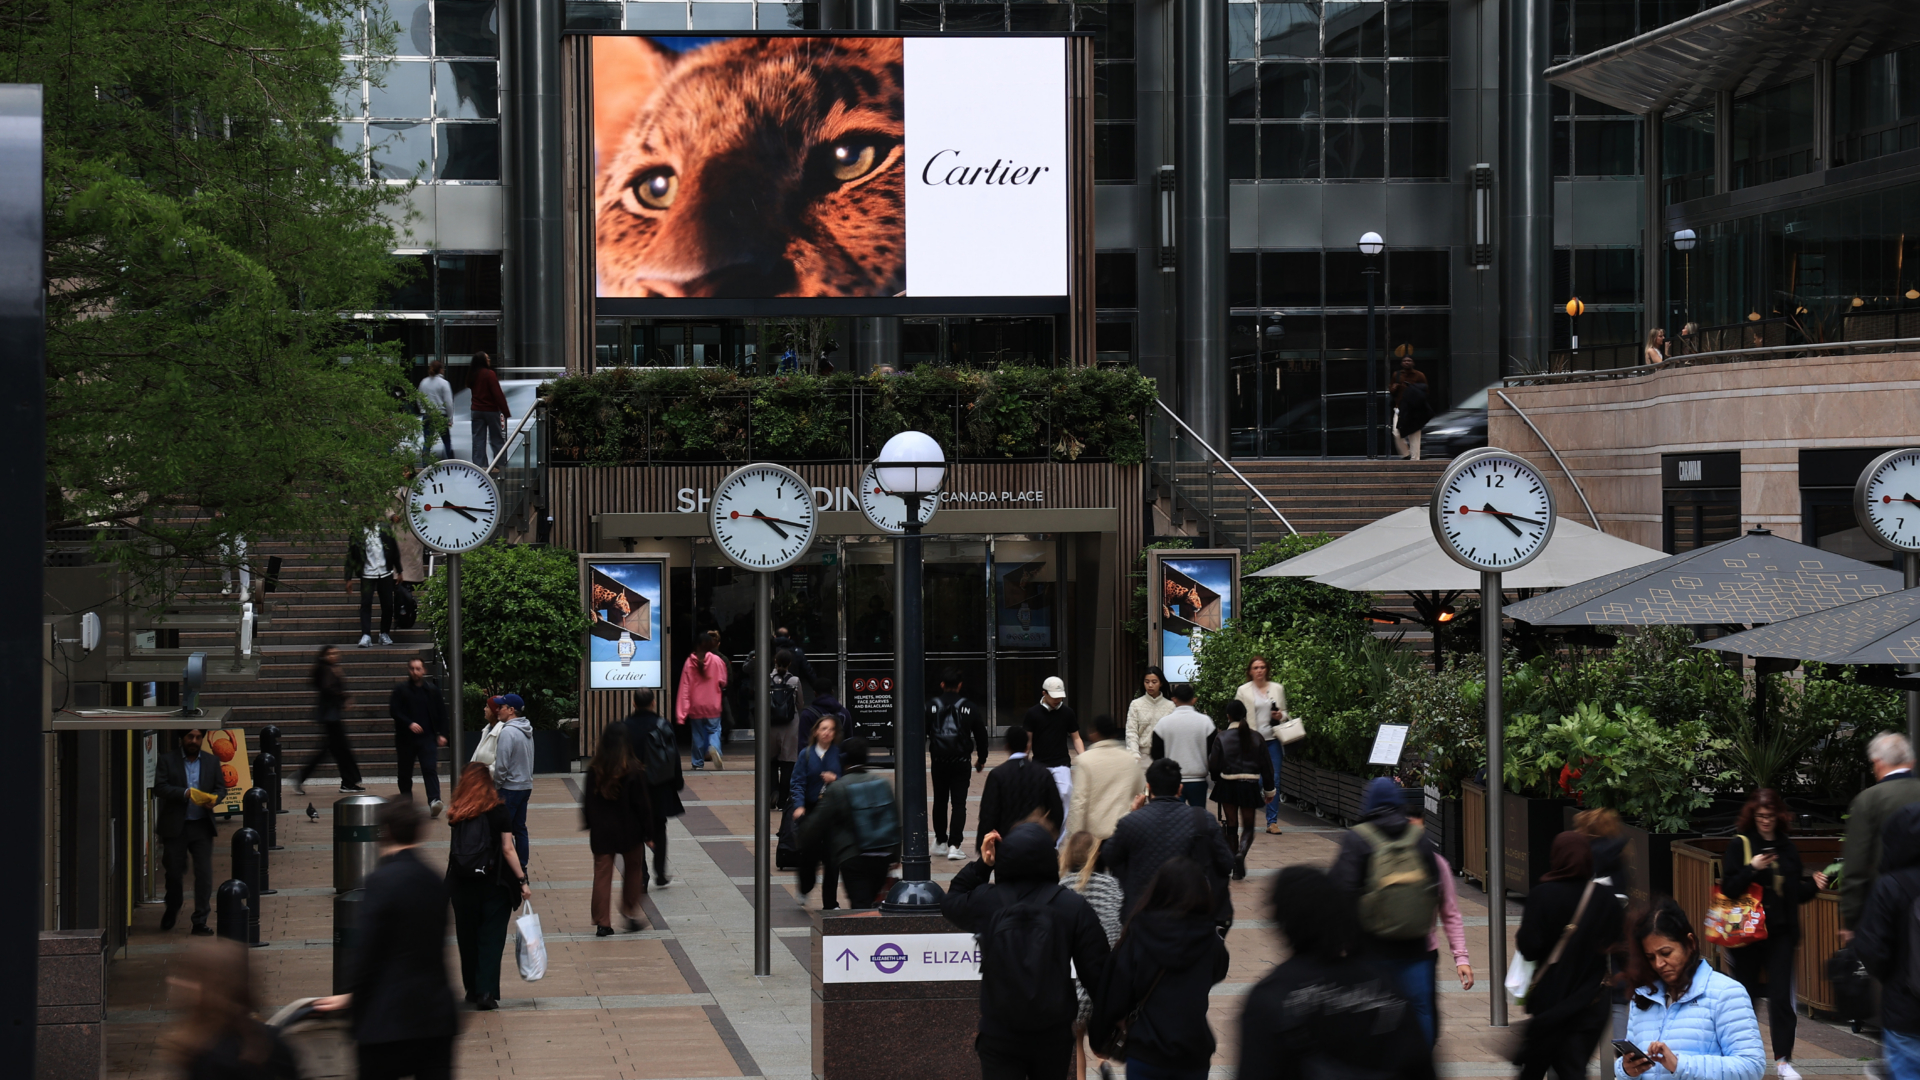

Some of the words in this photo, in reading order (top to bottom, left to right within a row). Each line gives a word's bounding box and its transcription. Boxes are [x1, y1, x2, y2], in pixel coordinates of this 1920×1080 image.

[922, 149, 1049, 185] Cartier
[1486, 474, 1504, 488] 12
[432, 483, 443, 494] 11
[776, 486, 781, 499] 1
[676, 488, 713, 513] SH
[811, 487, 862, 512] DIN
[940, 491, 998, 502] CANADA
[1001, 491, 1043, 502] PLACE
[1896, 518, 1904, 529] 7
[605, 668, 646, 681] Cartier
[923, 951, 982, 964] ELIZAB
